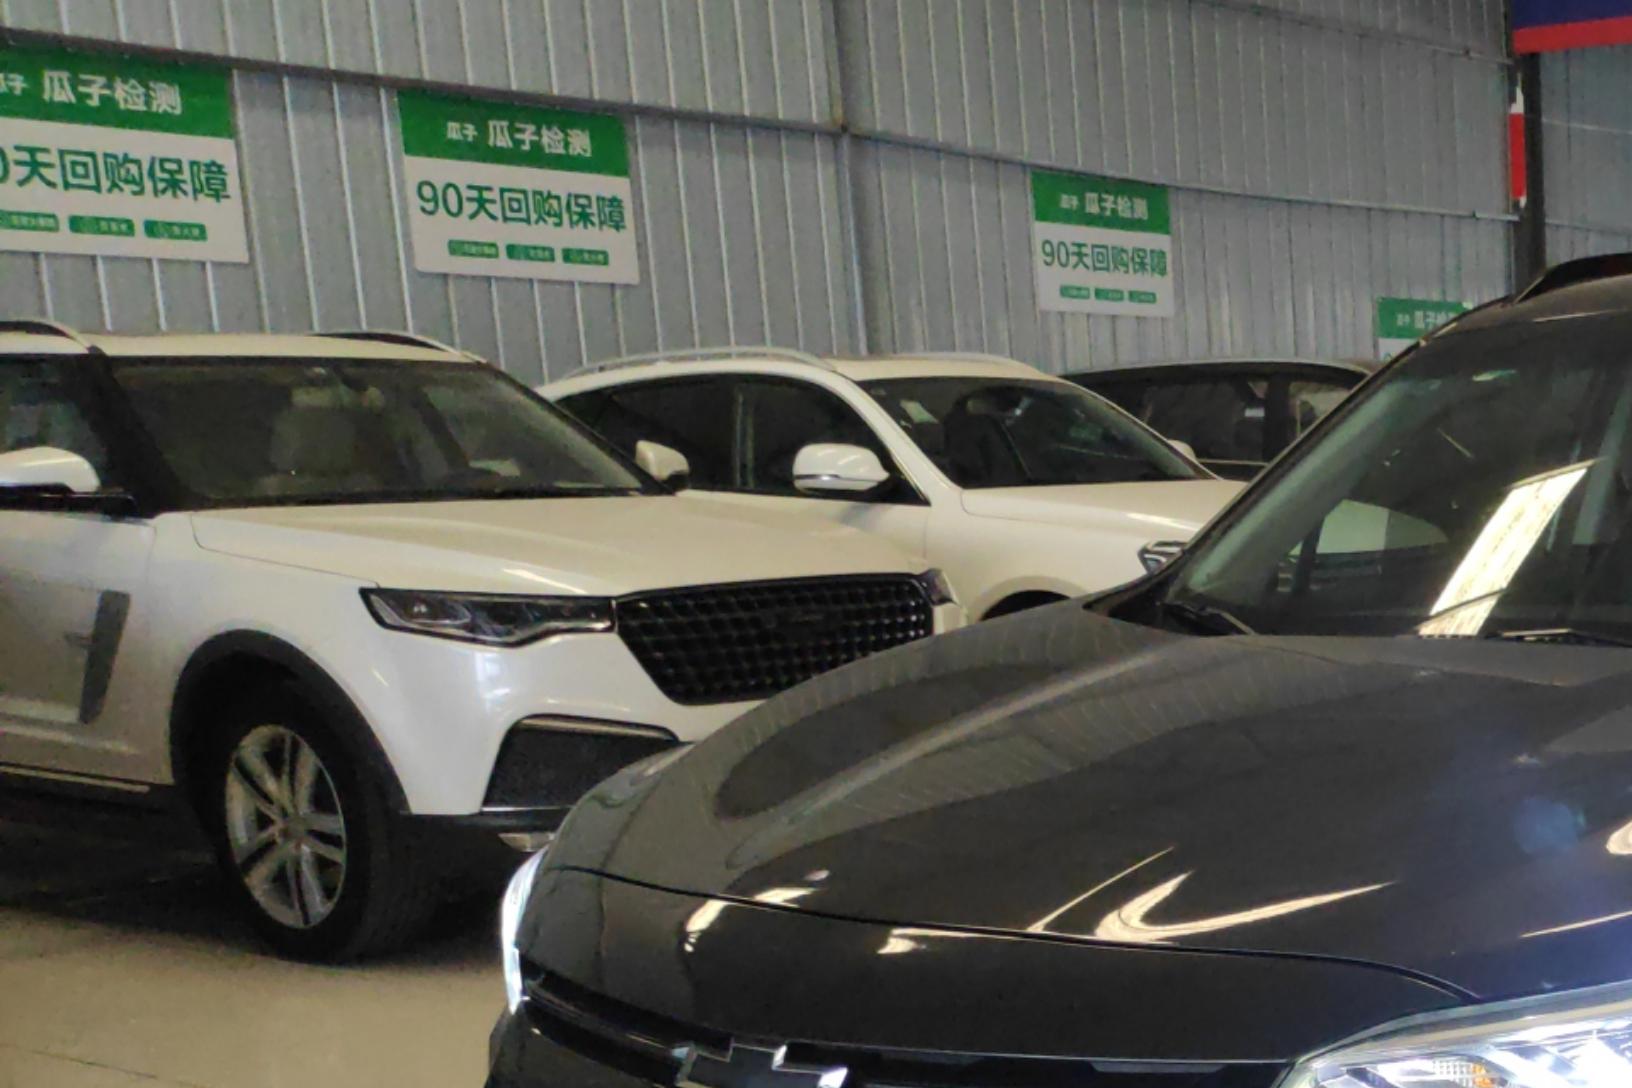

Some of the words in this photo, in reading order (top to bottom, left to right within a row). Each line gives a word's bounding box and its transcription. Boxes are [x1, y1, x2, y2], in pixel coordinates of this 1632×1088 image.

[42, 69, 183, 116] 瓜子检测
[488, 119, 592, 157] 瓜子检测
[416, 180, 627, 233] 90天回购保障
[1041, 239, 1168, 277] 90天回购保障
